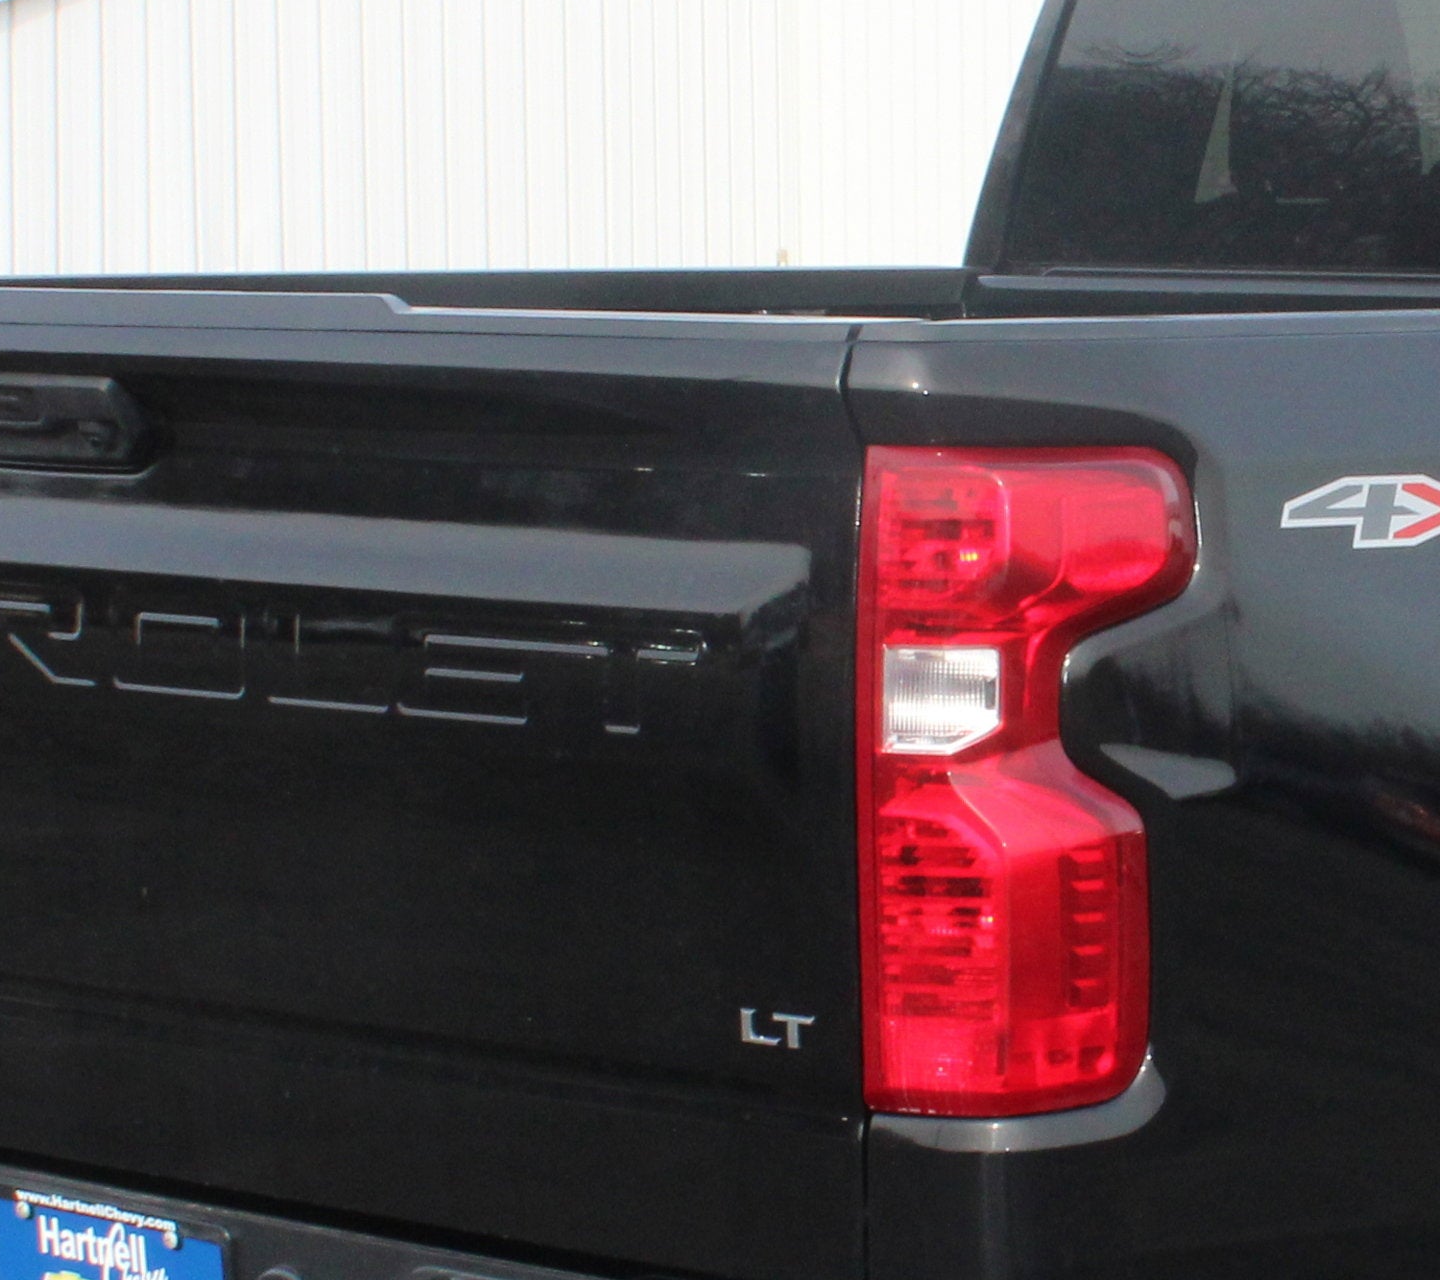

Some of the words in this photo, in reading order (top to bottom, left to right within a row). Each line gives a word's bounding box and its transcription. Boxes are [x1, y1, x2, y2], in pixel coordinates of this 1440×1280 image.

[740, 1008, 815, 1049] LT
[15, 1189, 176, 1232] www.HartnellChevy.com
[37, 1215, 147, 1271] Hartnell
